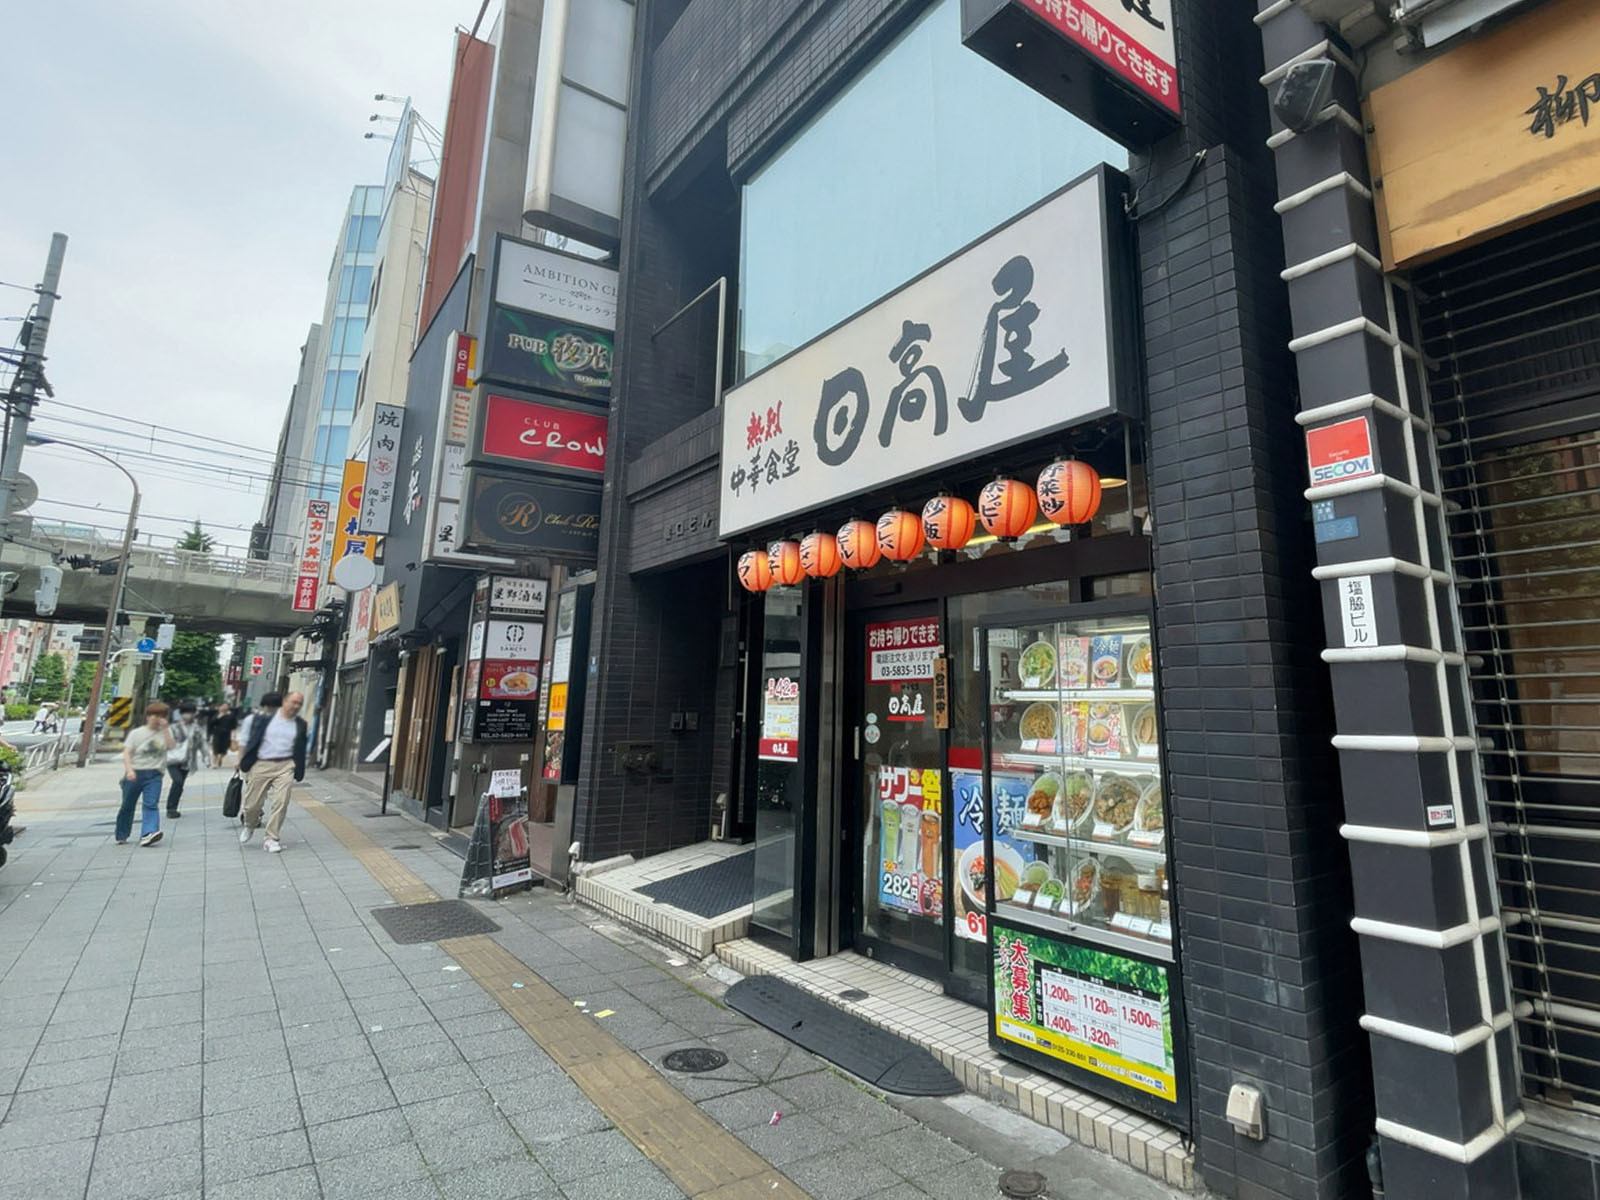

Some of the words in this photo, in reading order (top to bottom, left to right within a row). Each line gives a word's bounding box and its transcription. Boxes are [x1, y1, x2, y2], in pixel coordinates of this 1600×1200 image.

[523, 263, 600, 292] AMBITION
[508, 333, 548, 355] PUB
[456, 350, 468, 373] 6F
[813, 255, 1071, 467] 日高屋
[377, 411, 400, 452] 焼肉
[524, 417, 560, 430] CLUB
[746, 400, 783, 450] 熱烈
[519, 429, 605, 457] CROW
[730, 439, 800, 497] 中華食堂
[1314, 458, 1369, 481] SECOM
[923, 499, 946, 540] 炒飯
[983, 482, 1005, 527] ホッピー
[304, 519, 324, 559] カツ丼
[298, 578, 314, 609] お弁当
[1347, 581, 1368, 643] 塩脇ビル
[869, 623, 939, 648] お持ち帰りできま
[876, 650, 936, 664] 電話注文を承ります
[881, 664, 931, 677] 03-5835-1531
[888, 693, 926, 716] 日高屋
[1011, 939, 1033, 1022] 大募集
